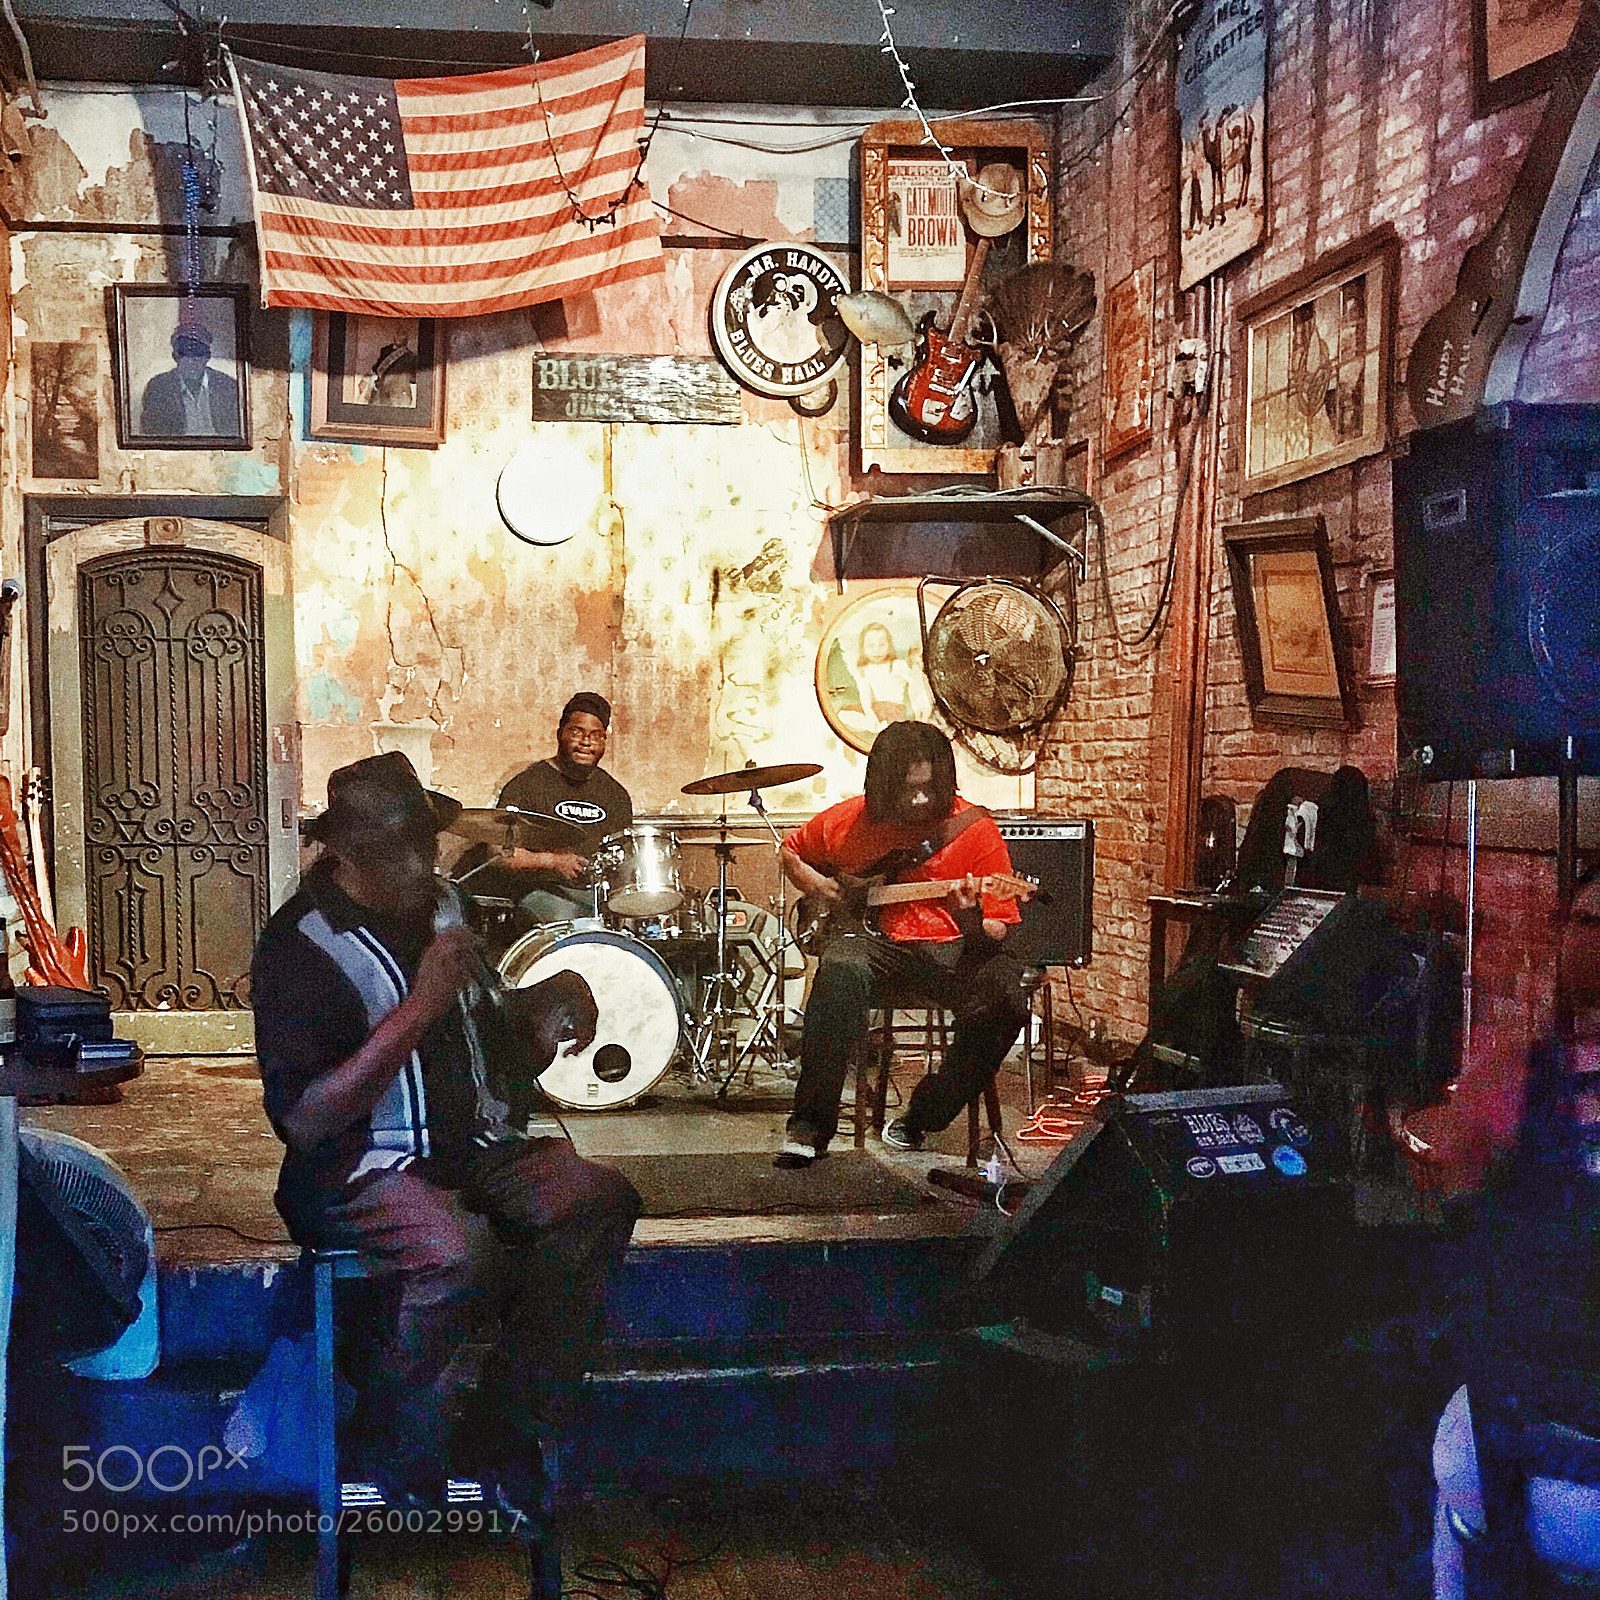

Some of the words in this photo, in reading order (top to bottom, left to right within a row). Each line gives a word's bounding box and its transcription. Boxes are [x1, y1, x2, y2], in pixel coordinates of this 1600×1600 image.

[1183, 8, 1264, 85] CIGARETTES
[908, 217, 957, 247] BROWN
[747, 254, 780, 279] MR.
[730, 328, 775, 379] BLUES
[781, 358, 826, 384] HALL
[537, 358, 618, 391] BLUE
[272, 726, 290, 762] PULL
[561, 805, 600, 818] EVANS
